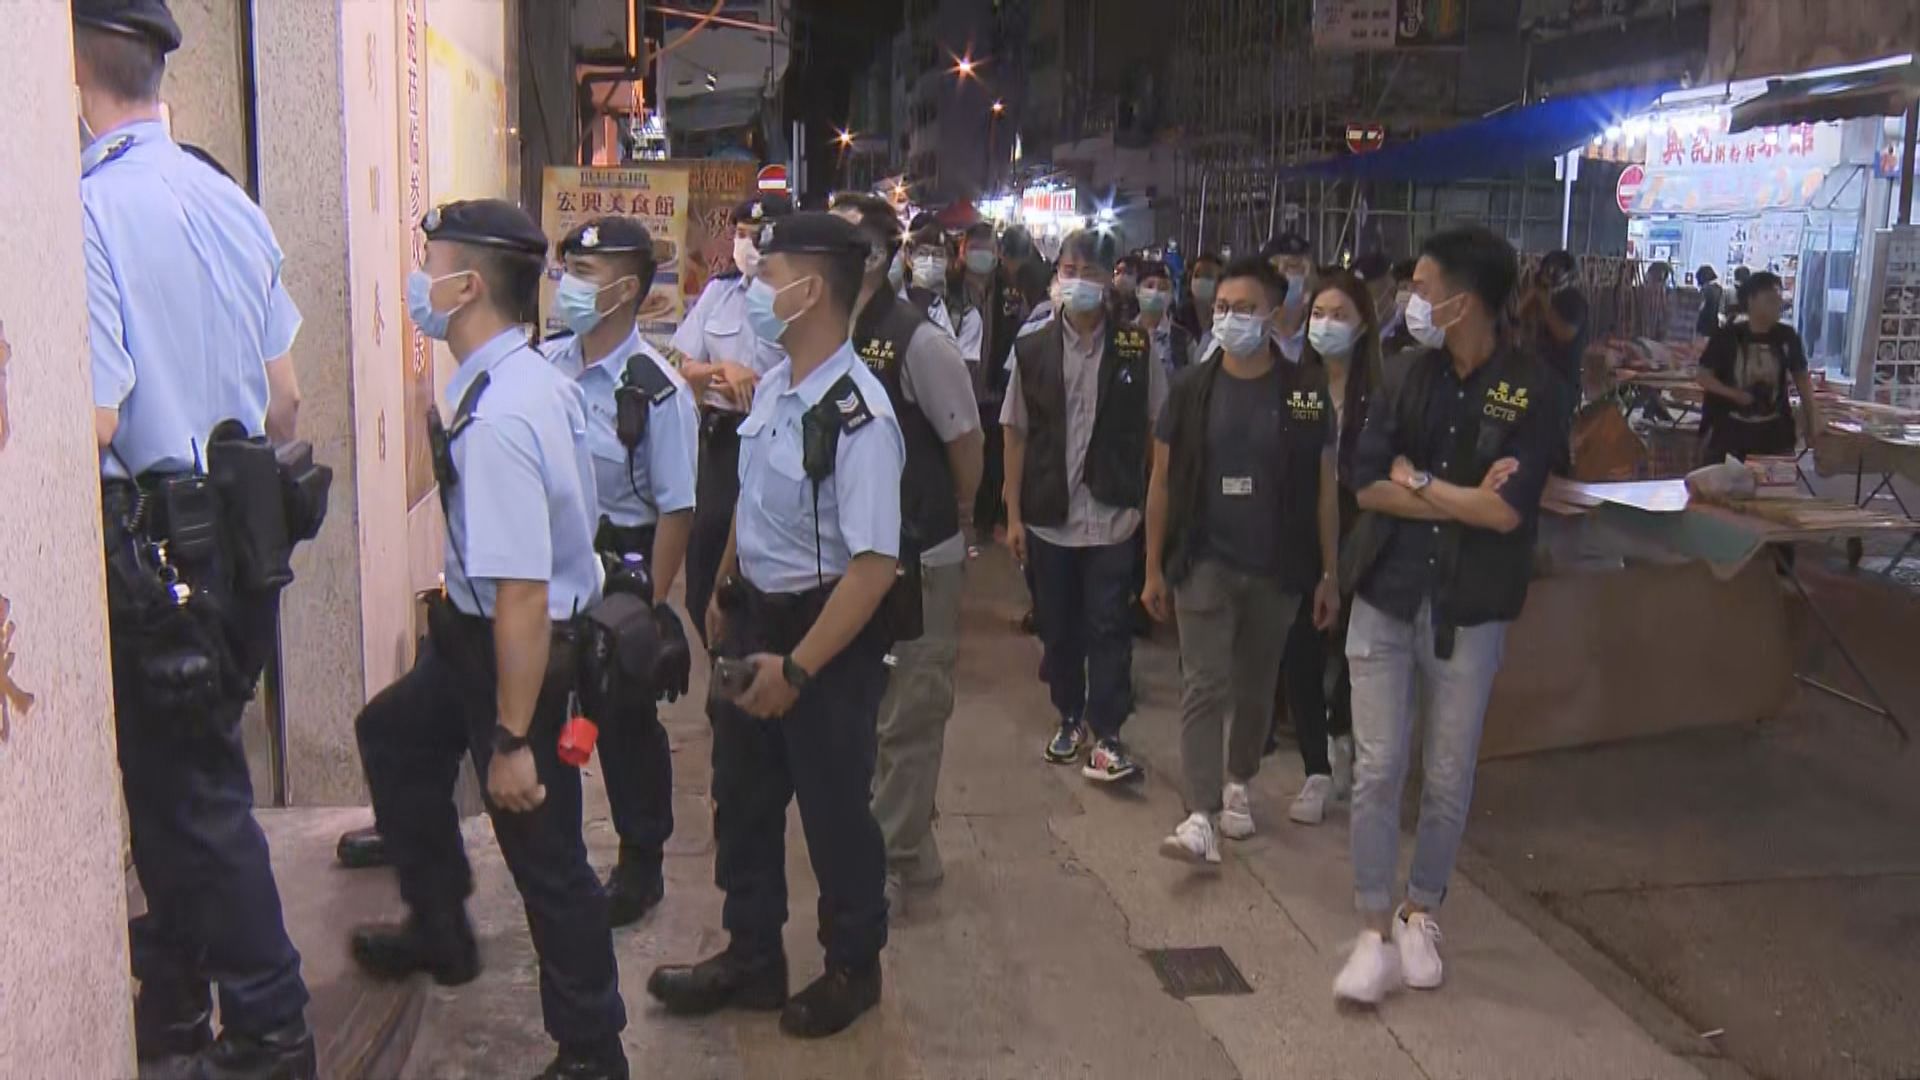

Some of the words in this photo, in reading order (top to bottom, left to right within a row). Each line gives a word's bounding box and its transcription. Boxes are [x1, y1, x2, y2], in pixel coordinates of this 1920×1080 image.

[557, 191, 675, 217] 宏興美食館
[1286, 398, 1324, 410] POLICE
[1486, 387, 1528, 409] POLICE
[1483, 403, 1517, 421] OCTB
